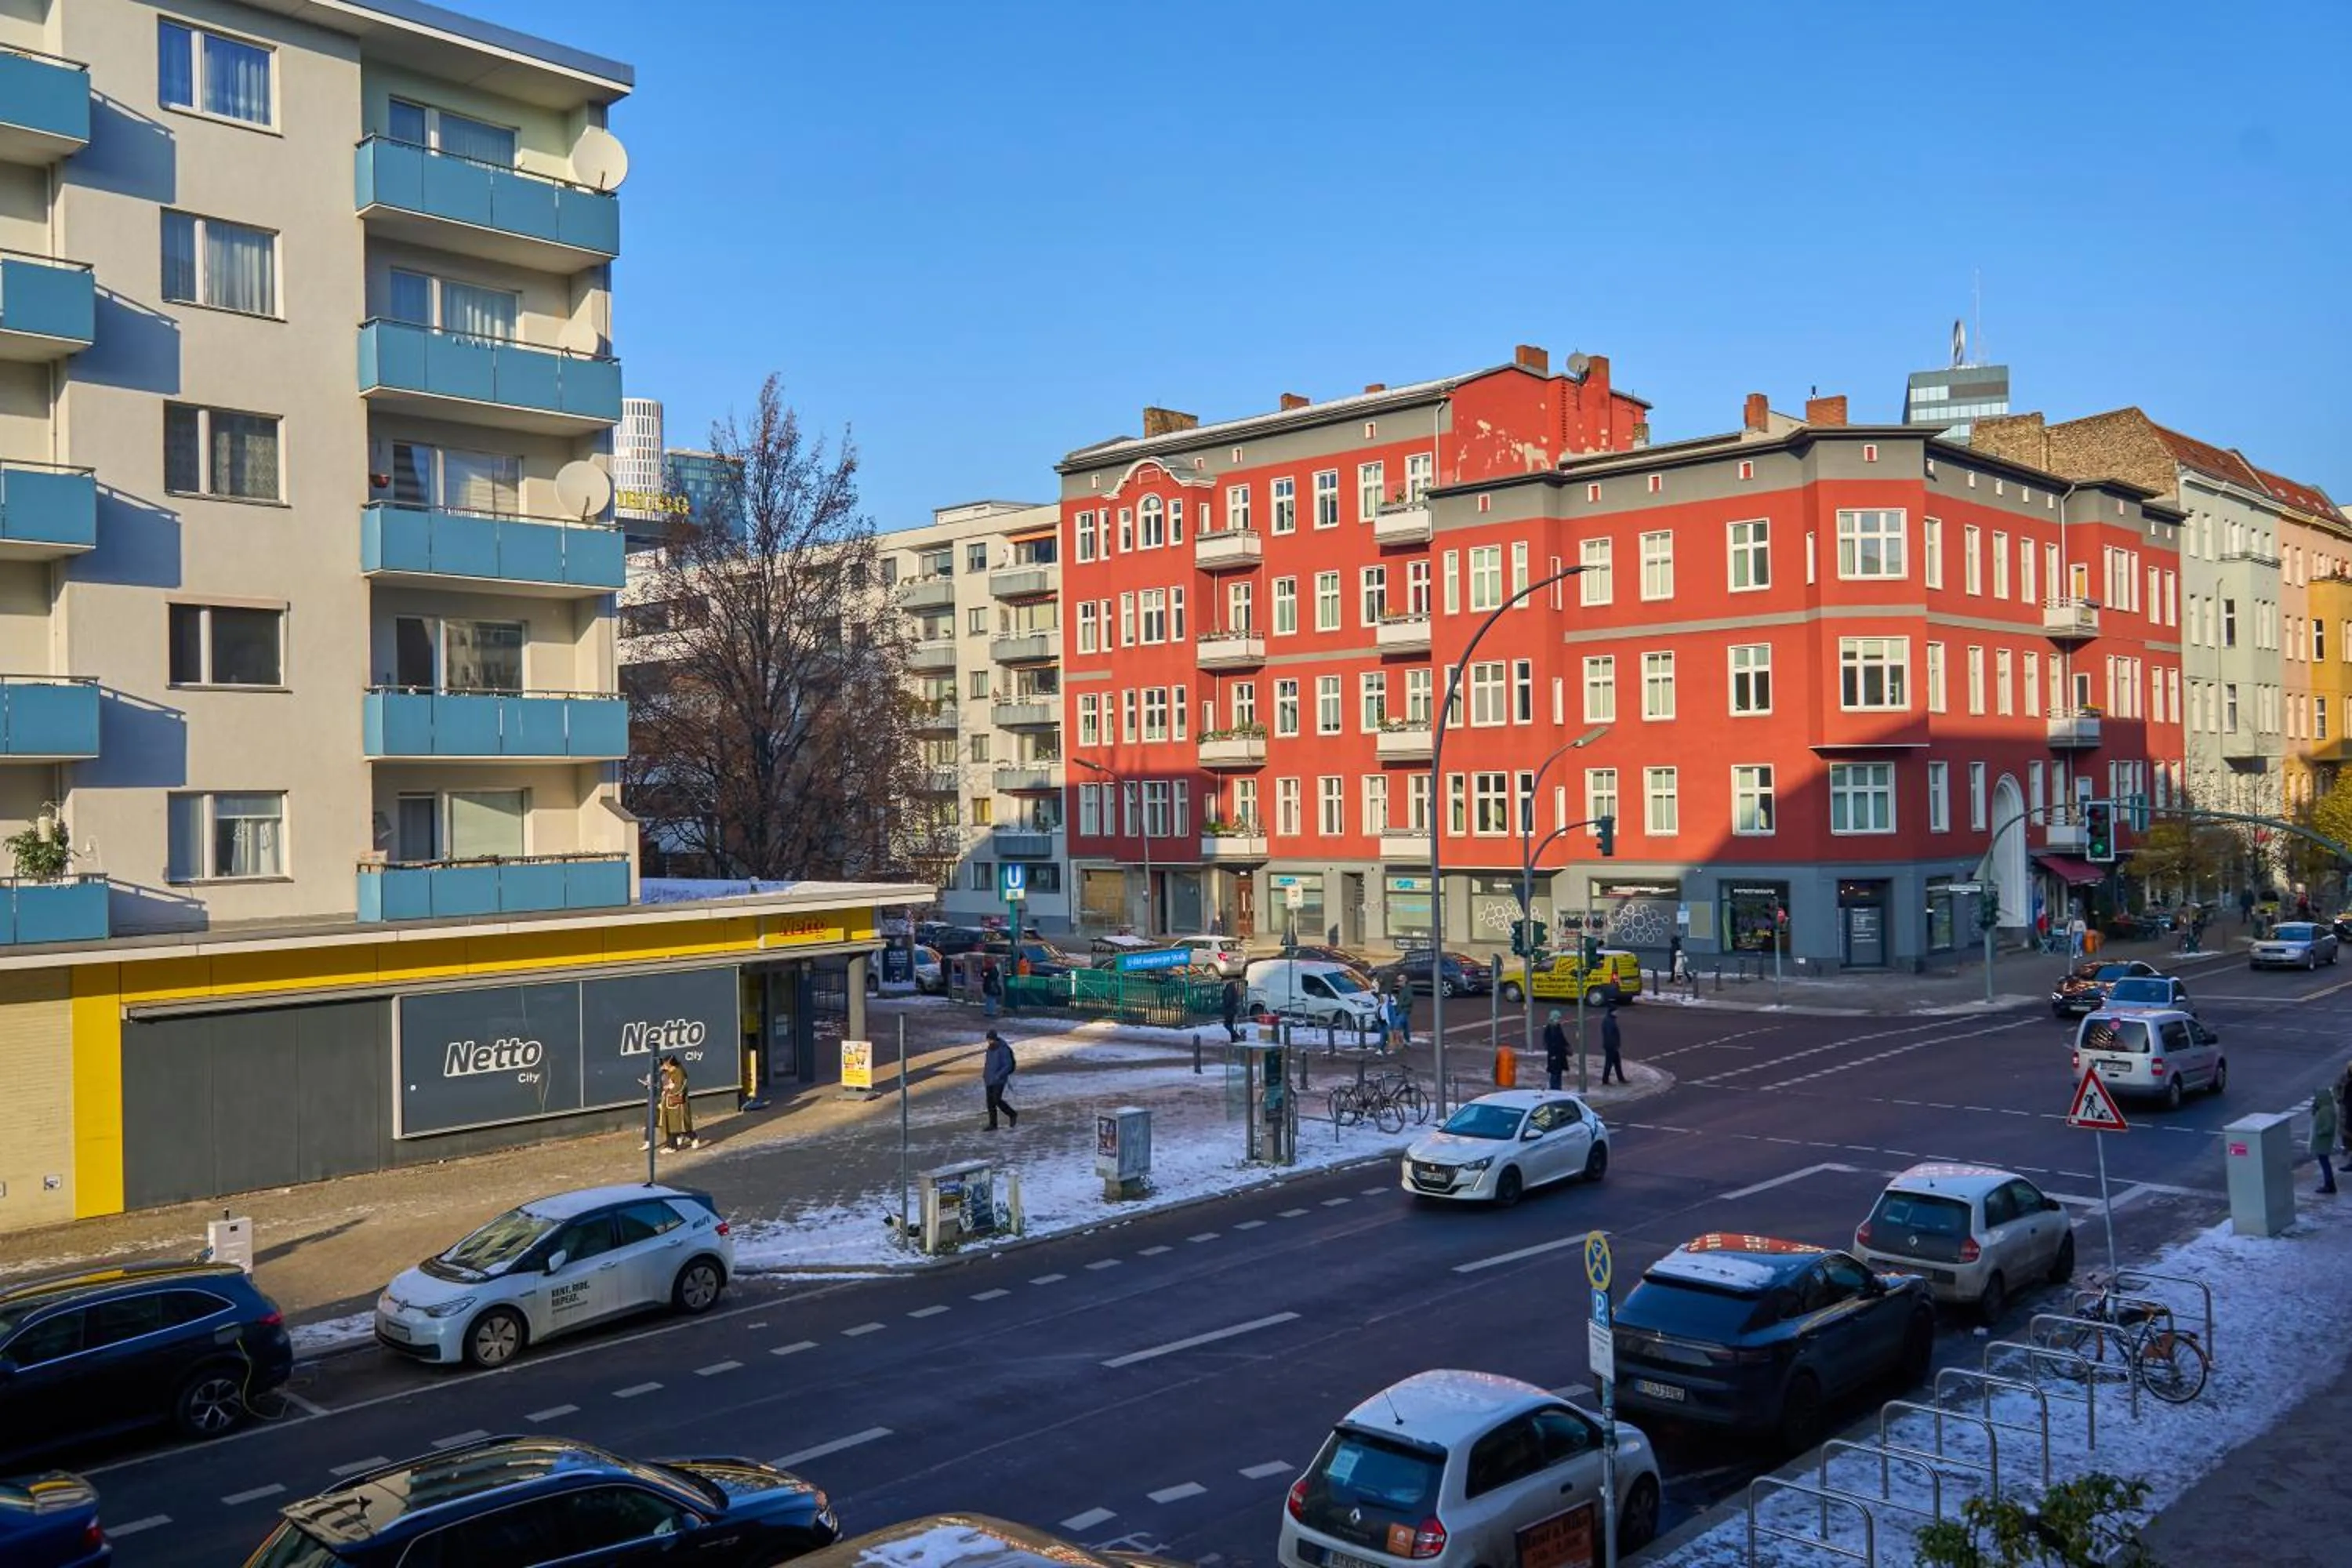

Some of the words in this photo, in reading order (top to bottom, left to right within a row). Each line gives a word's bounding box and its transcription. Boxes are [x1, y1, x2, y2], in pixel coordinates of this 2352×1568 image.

[1007, 865, 1022, 887] U
[780, 916, 828, 936] Netto
[620, 1019, 705, 1055] Netto
[445, 1038, 542, 1078] Netto
[684, 1051, 703, 1062] City
[518, 1073, 540, 1083] City
[1595, 1294, 1605, 1318] P
